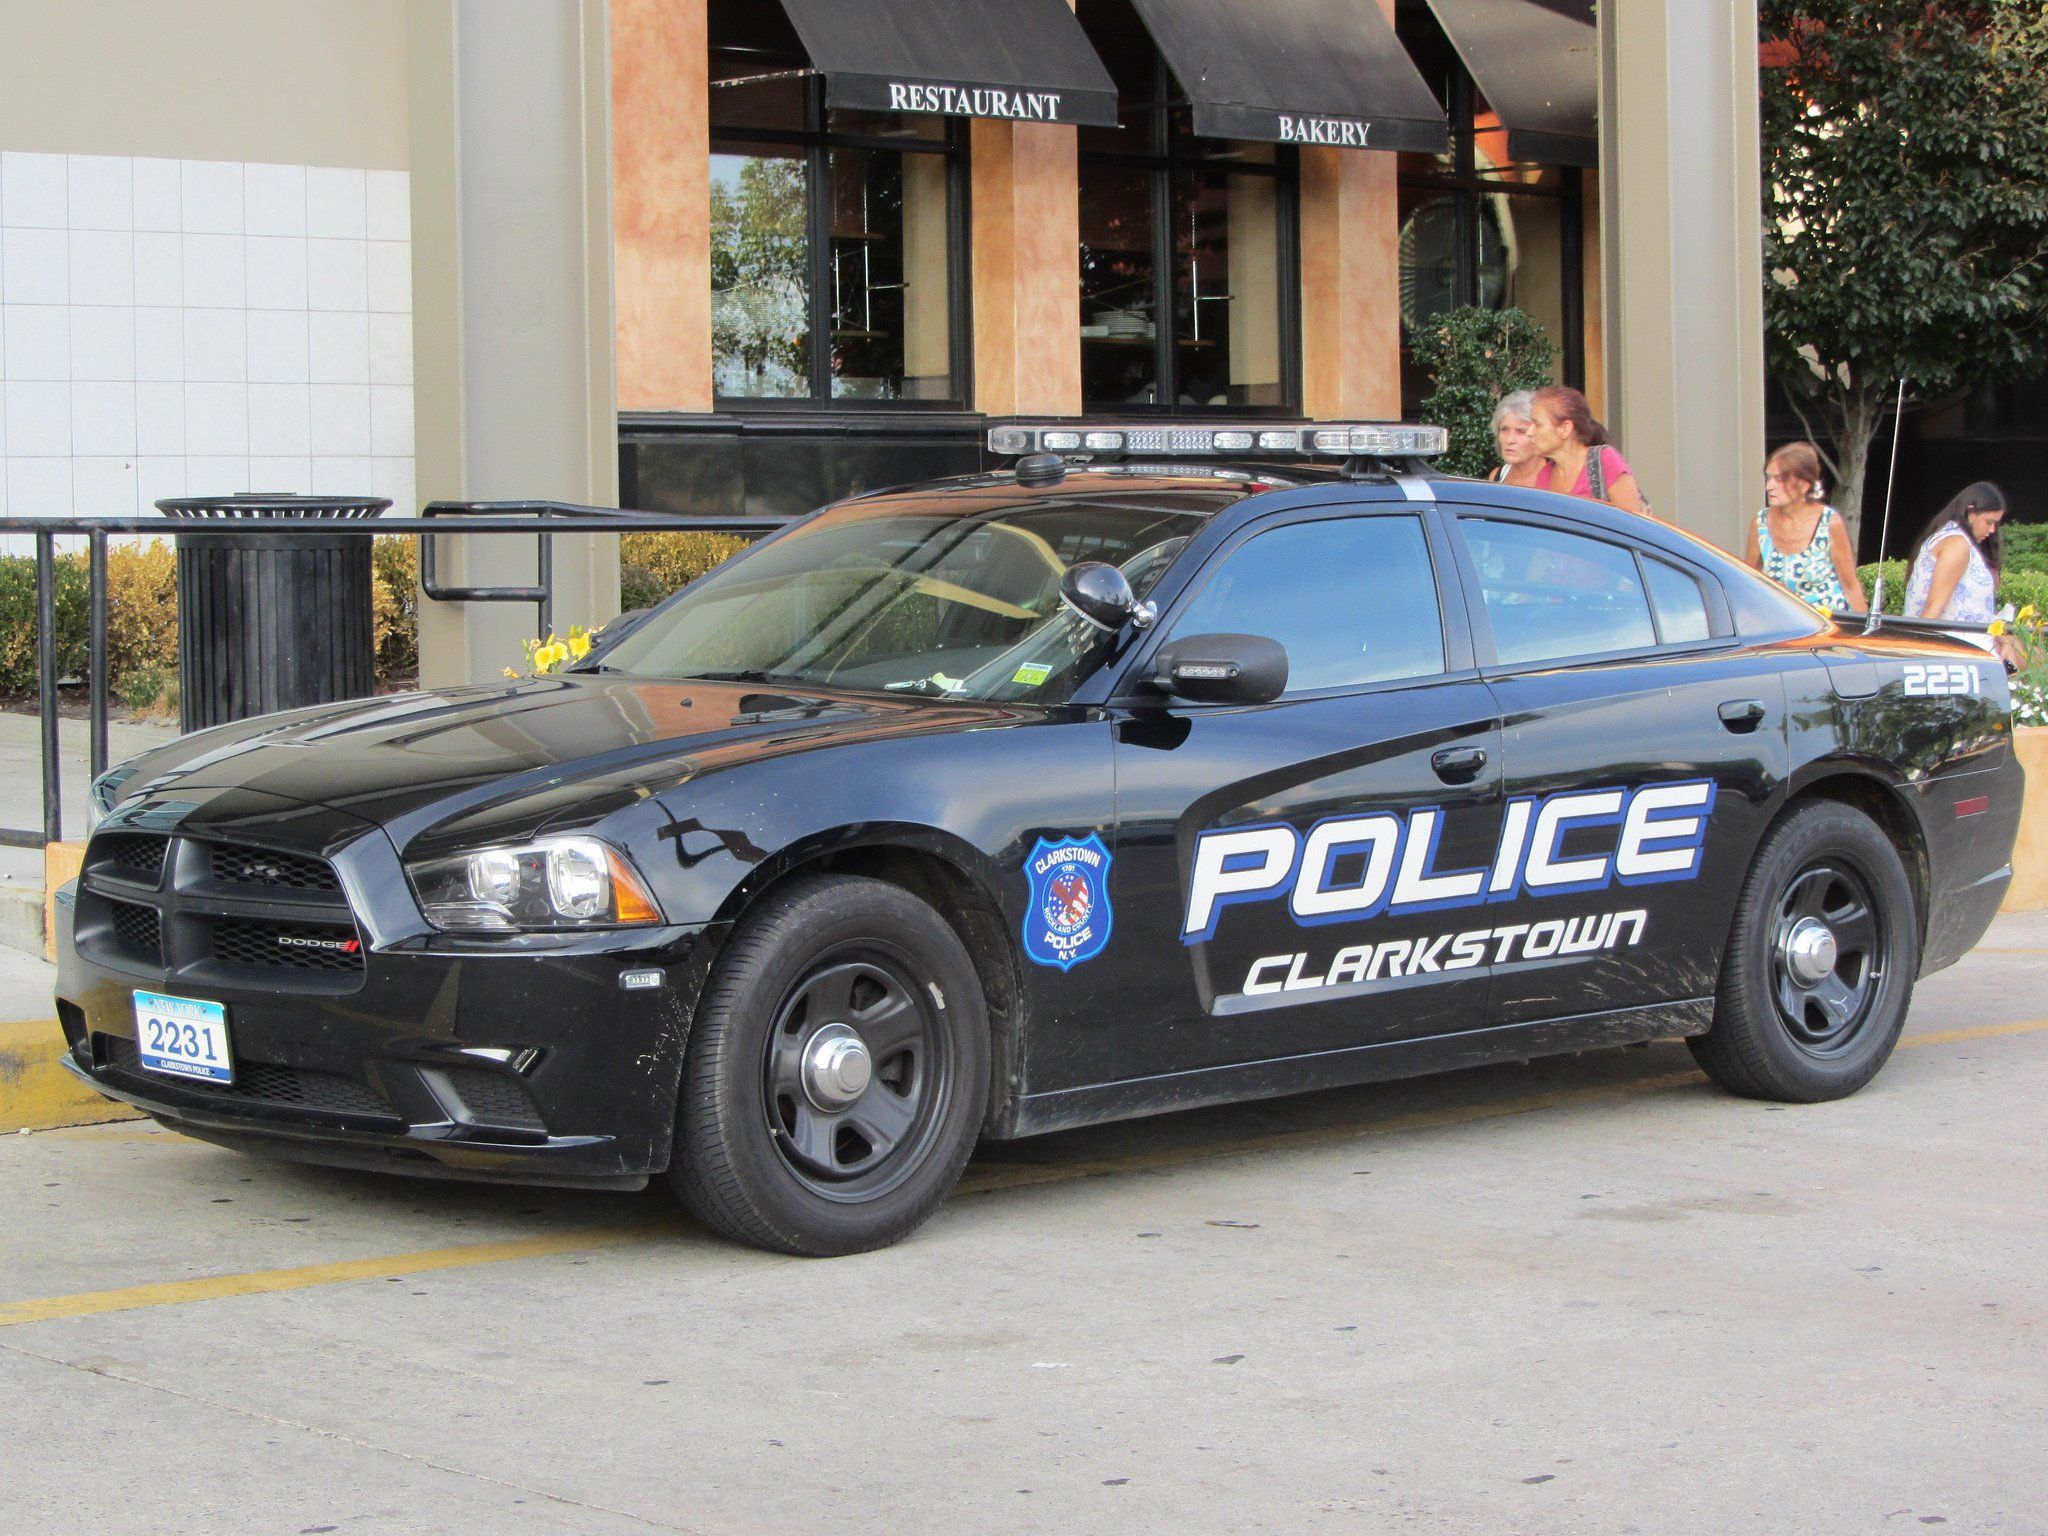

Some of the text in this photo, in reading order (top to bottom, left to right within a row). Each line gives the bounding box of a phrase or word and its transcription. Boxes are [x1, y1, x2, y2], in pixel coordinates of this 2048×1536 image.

[888, 83, 1061, 120] RESTAURANT
[1278, 116, 1371, 146] BAKERY
[1903, 665, 1980, 696] 2231
[1035, 847, 1101, 875] CLARKSTOWN
[1181, 780, 1714, 942] POLICE
[1043, 903, 1093, 934] ROCKLAND COUNTY
[278, 937, 348, 950] DODGE
[1044, 926, 1093, 950] POLICE
[1242, 909, 1647, 996] CLARKSTOWN
[1058, 949, 1077, 960] N.Y.
[155, 999, 202, 1018] NEW YORK
[148, 1018, 217, 1061] 2231
[161, 1060, 211, 1076] CLARKSTOWN POLICE
